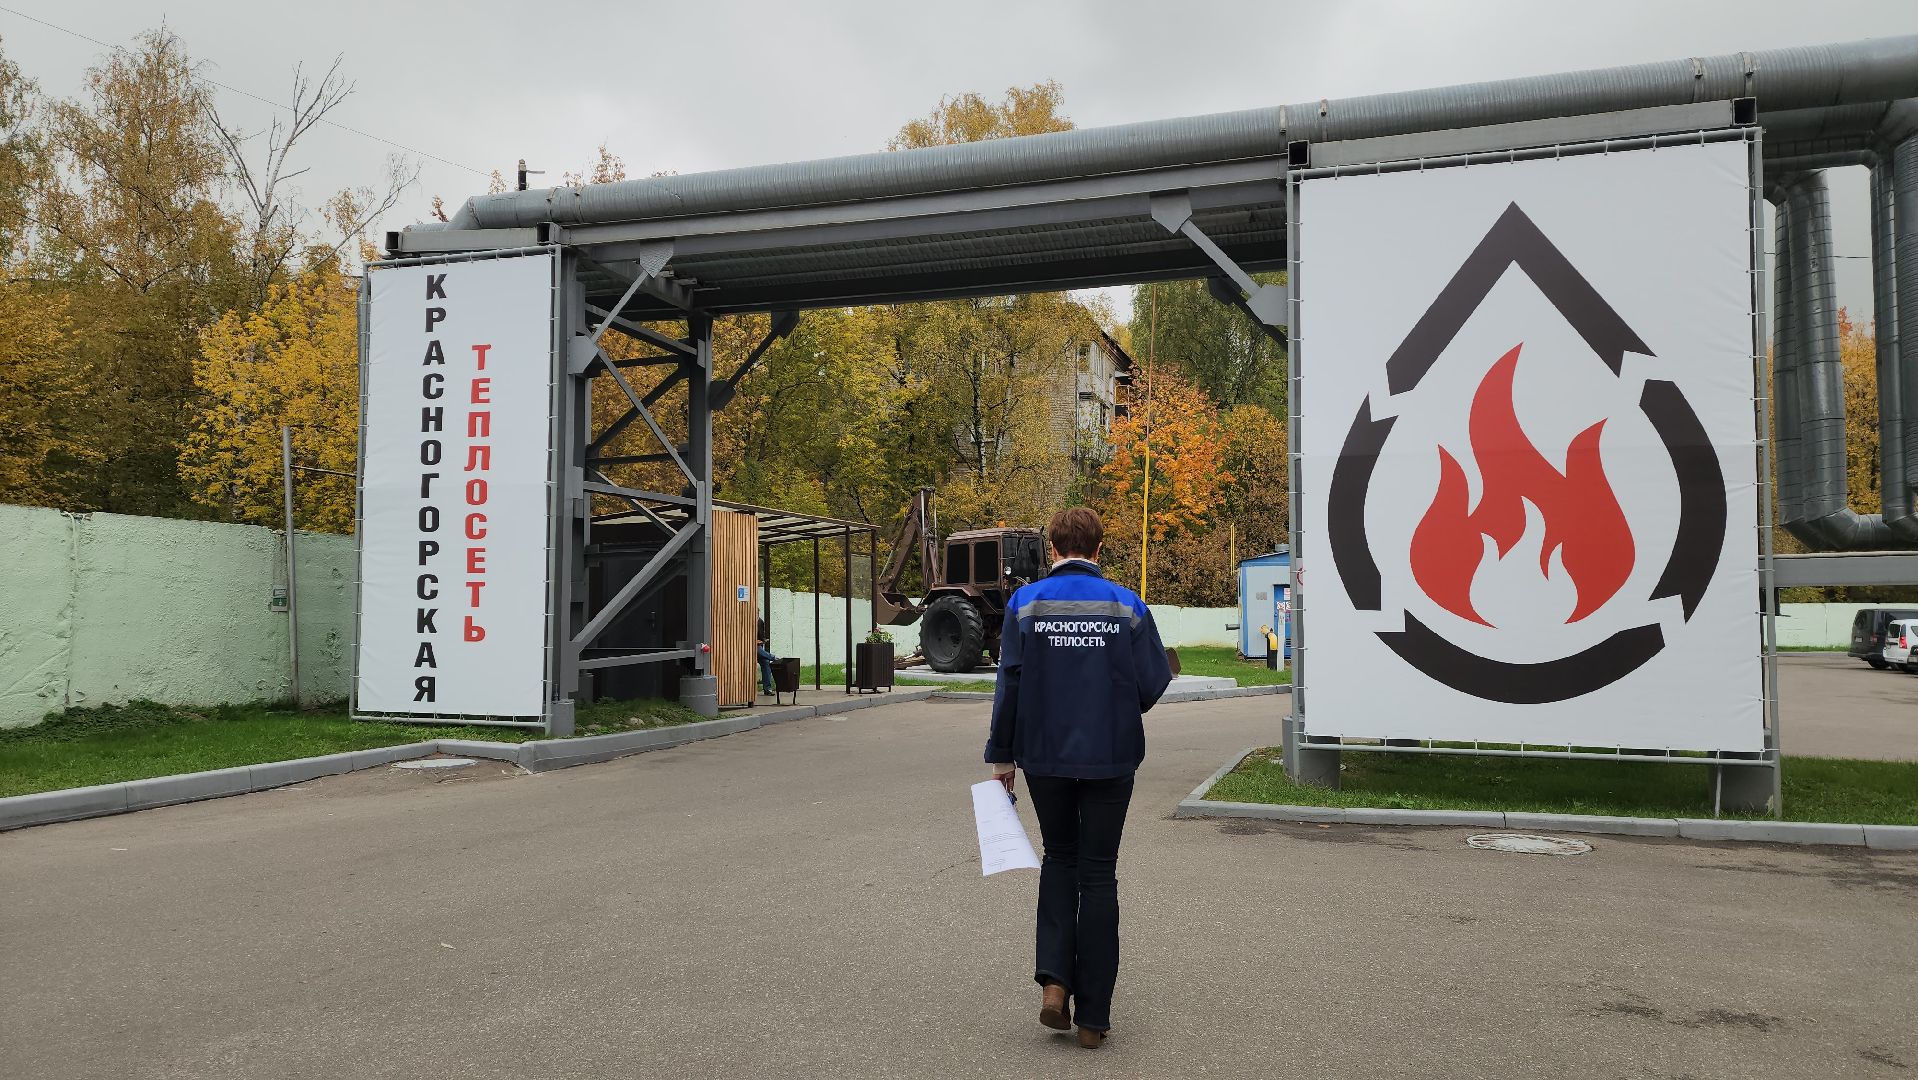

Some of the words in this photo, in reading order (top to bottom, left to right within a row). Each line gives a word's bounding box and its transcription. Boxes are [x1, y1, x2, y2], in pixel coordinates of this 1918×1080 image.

[413, 273, 448, 703] КРАСНОГОРСКАЯ
[463, 344, 492, 643] ТЕПЛОСЕТЬ
[1034, 621, 1120, 634] КРАСНОГОРСКАЯ
[1048, 635, 1106, 647] ТЕПЛОСЕТЬ
